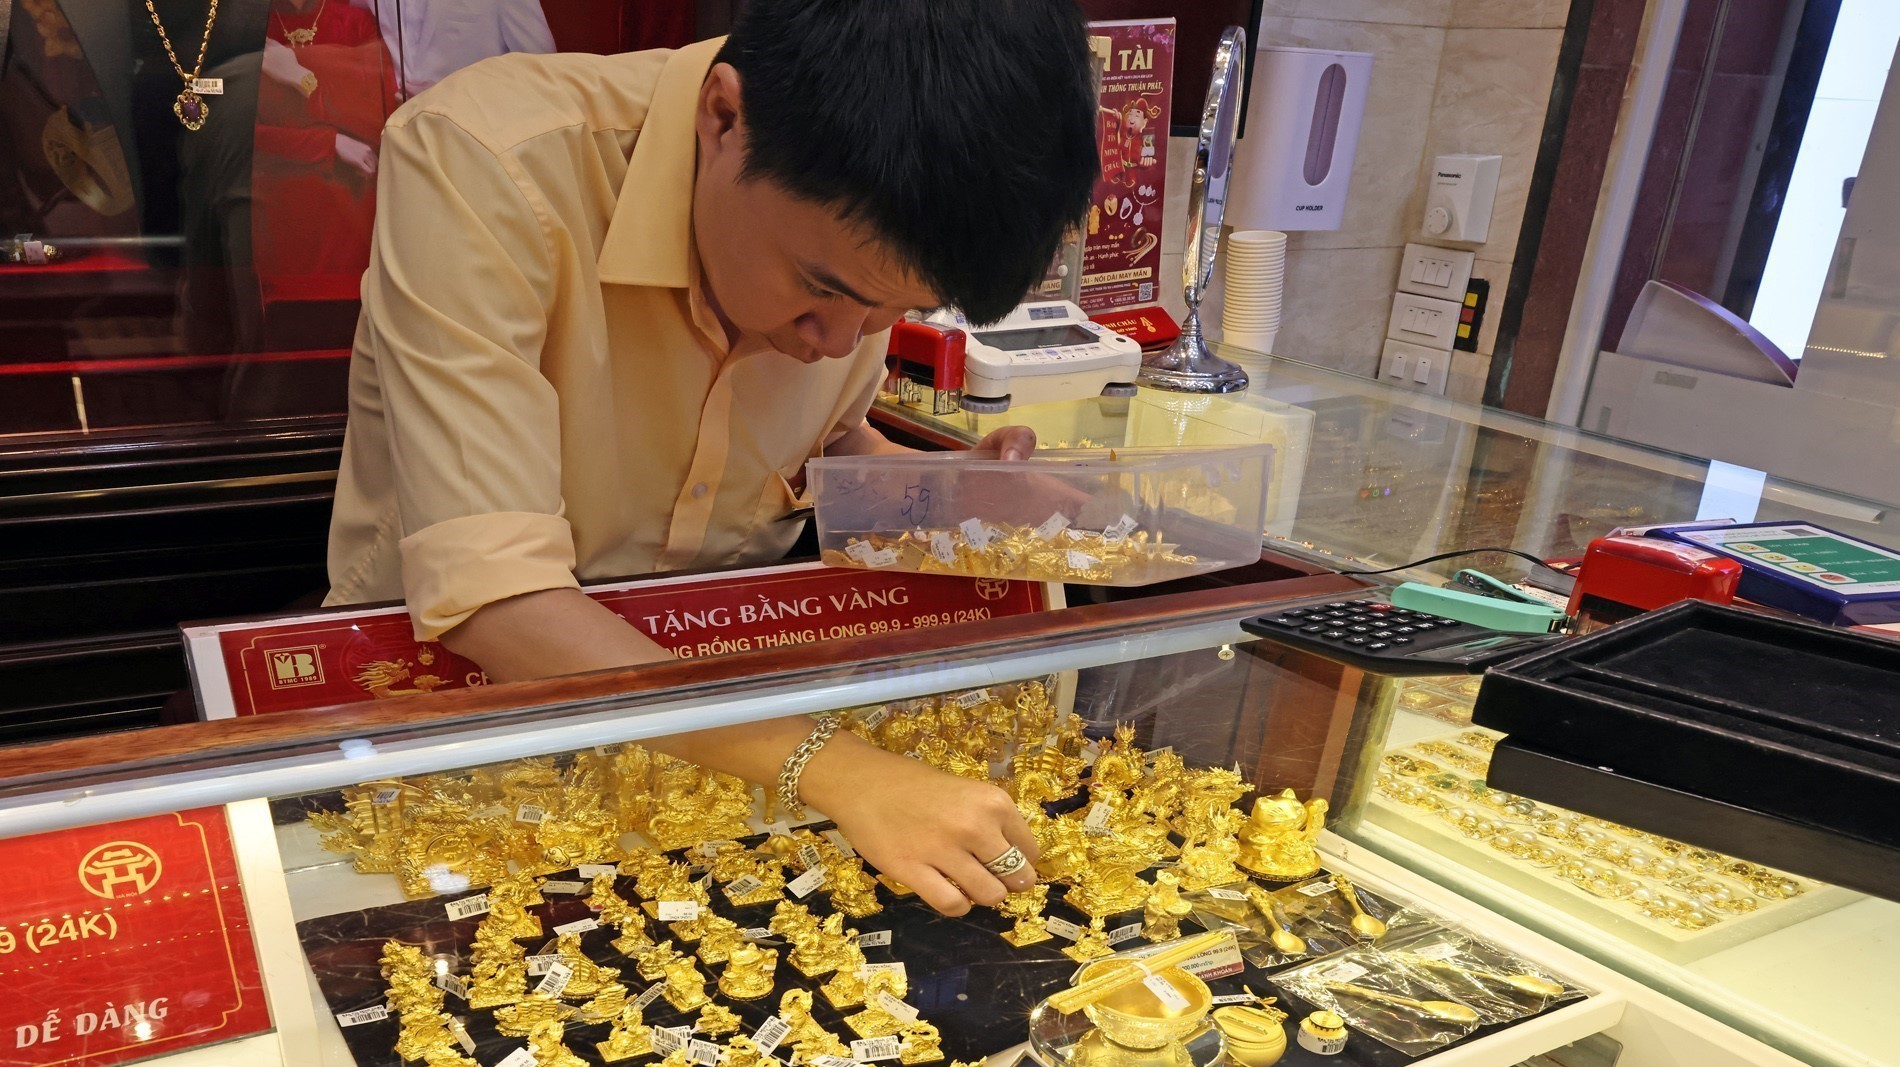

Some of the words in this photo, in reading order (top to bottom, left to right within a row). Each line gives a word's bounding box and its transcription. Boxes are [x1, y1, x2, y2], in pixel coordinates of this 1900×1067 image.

[1118, 44, 1154, 70] TÀI
[1108, 82, 1127, 92] THÔNG
[1147, 80, 1162, 90] PHÁT
[642, 607, 731, 638] TẶNG
[739, 594, 822, 624] BẰNG
[829, 587, 908, 612] VÀNG
[697, 636, 751, 657] RỒNG
[754, 630, 816, 648] THĂNG
[820, 622, 866, 640] LONG
[870, 619, 900, 634] 99.9
[912, 612, 950, 628] 999.9
[954, 606, 990, 624] (24K)
[0, 930, 16, 954] 9
[26, 912, 117, 954] (24K)
[16, 1008, 62, 1048] DỄ
[76, 997, 169, 1036] DÀNG
